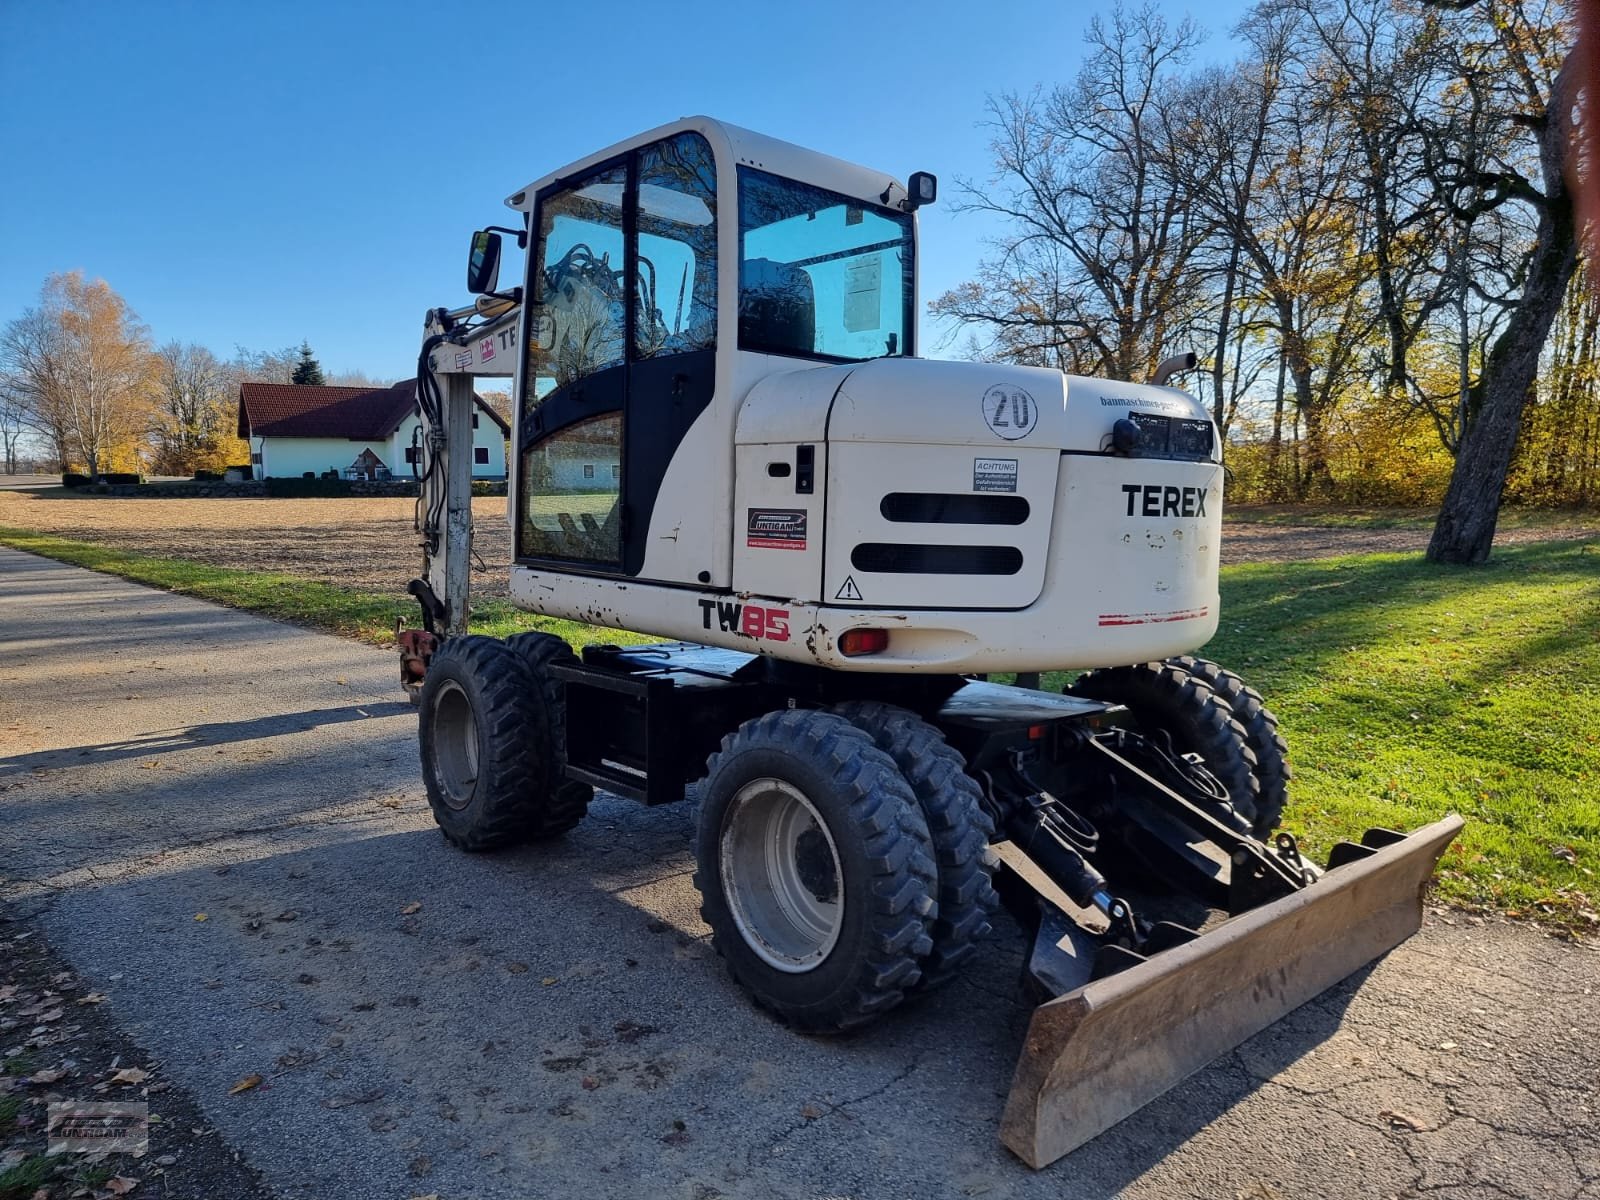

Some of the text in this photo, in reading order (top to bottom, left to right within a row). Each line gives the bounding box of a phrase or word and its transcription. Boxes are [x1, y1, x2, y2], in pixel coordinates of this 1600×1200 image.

[991, 391, 1028, 428] 20
[977, 463, 1016, 471] ACHTUNG
[1122, 484, 1207, 517] TEREX
[698, 599, 790, 642] TW85
